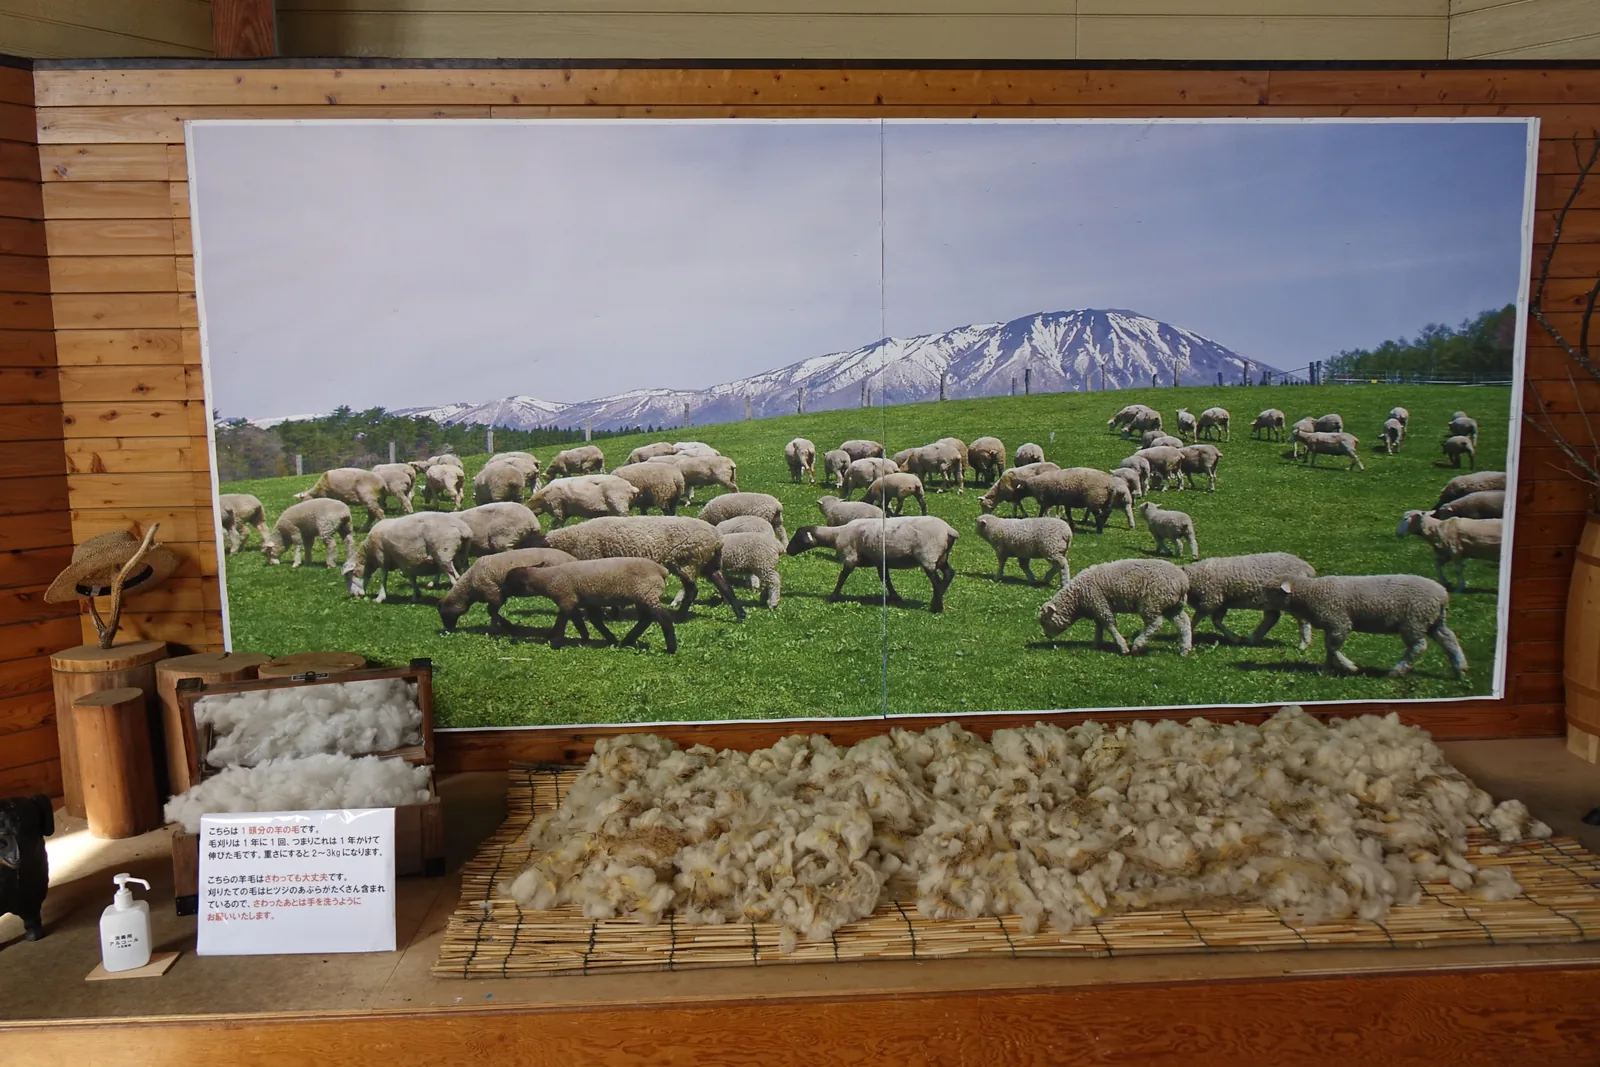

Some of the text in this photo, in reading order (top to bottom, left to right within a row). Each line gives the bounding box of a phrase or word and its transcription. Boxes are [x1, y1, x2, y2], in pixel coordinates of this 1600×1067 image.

[109, 938, 139, 946] アルコール
